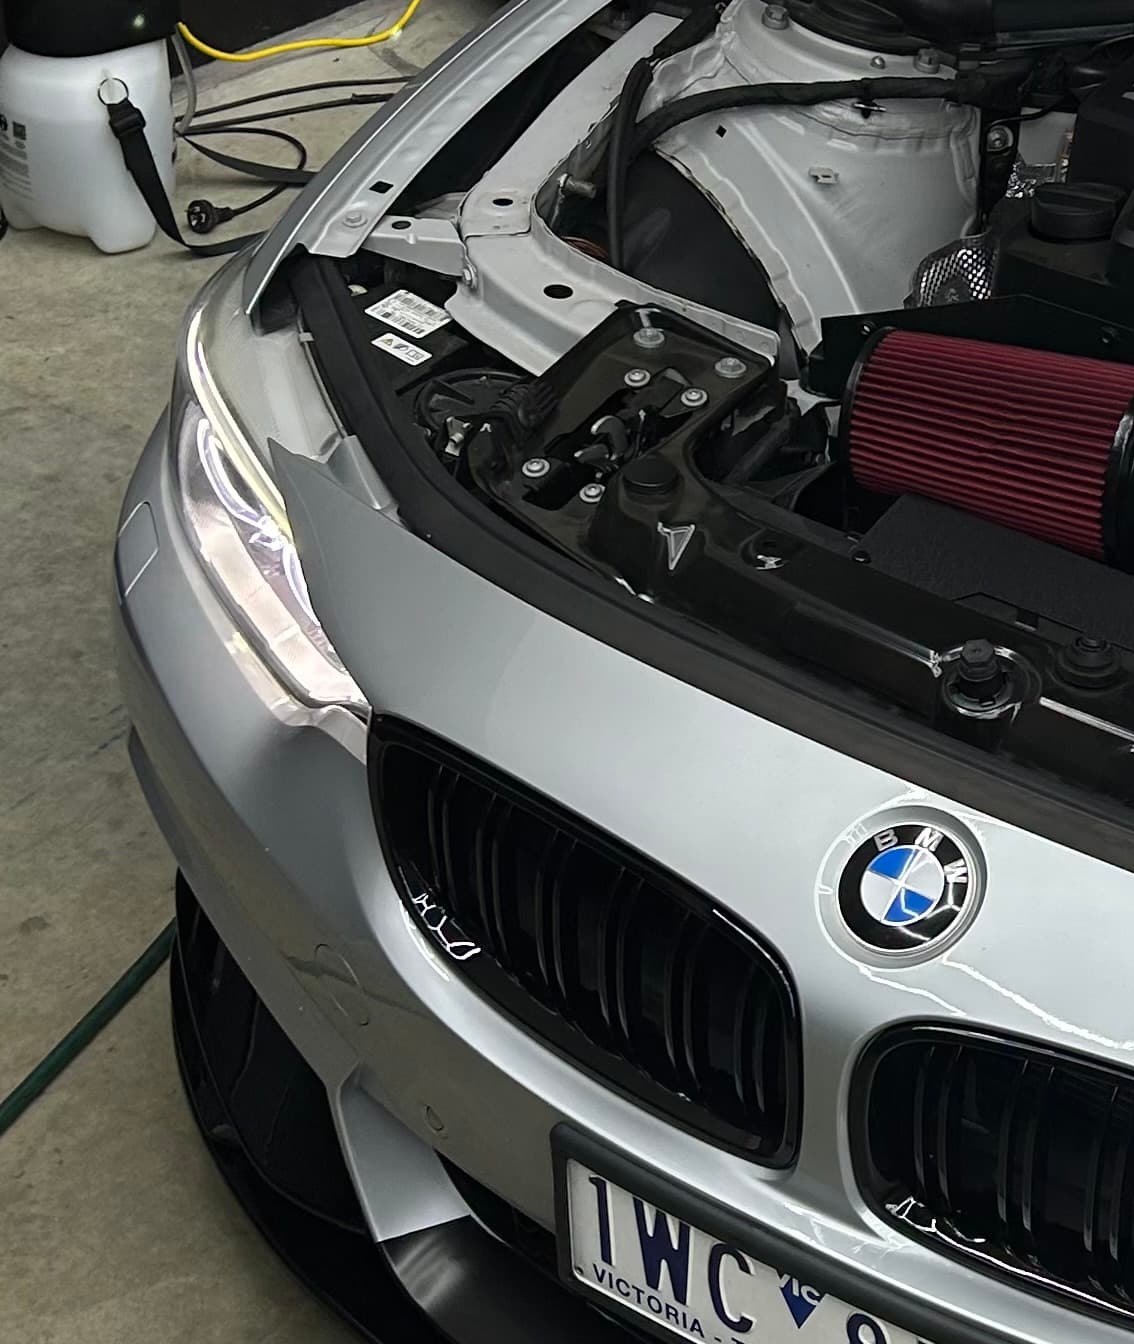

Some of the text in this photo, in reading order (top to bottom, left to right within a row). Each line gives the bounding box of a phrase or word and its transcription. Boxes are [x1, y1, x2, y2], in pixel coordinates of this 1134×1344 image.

[873, 827, 970, 884] BMW
[592, 1263, 705, 1338] VICTORIA
[776, 1268, 821, 1306] VIC
